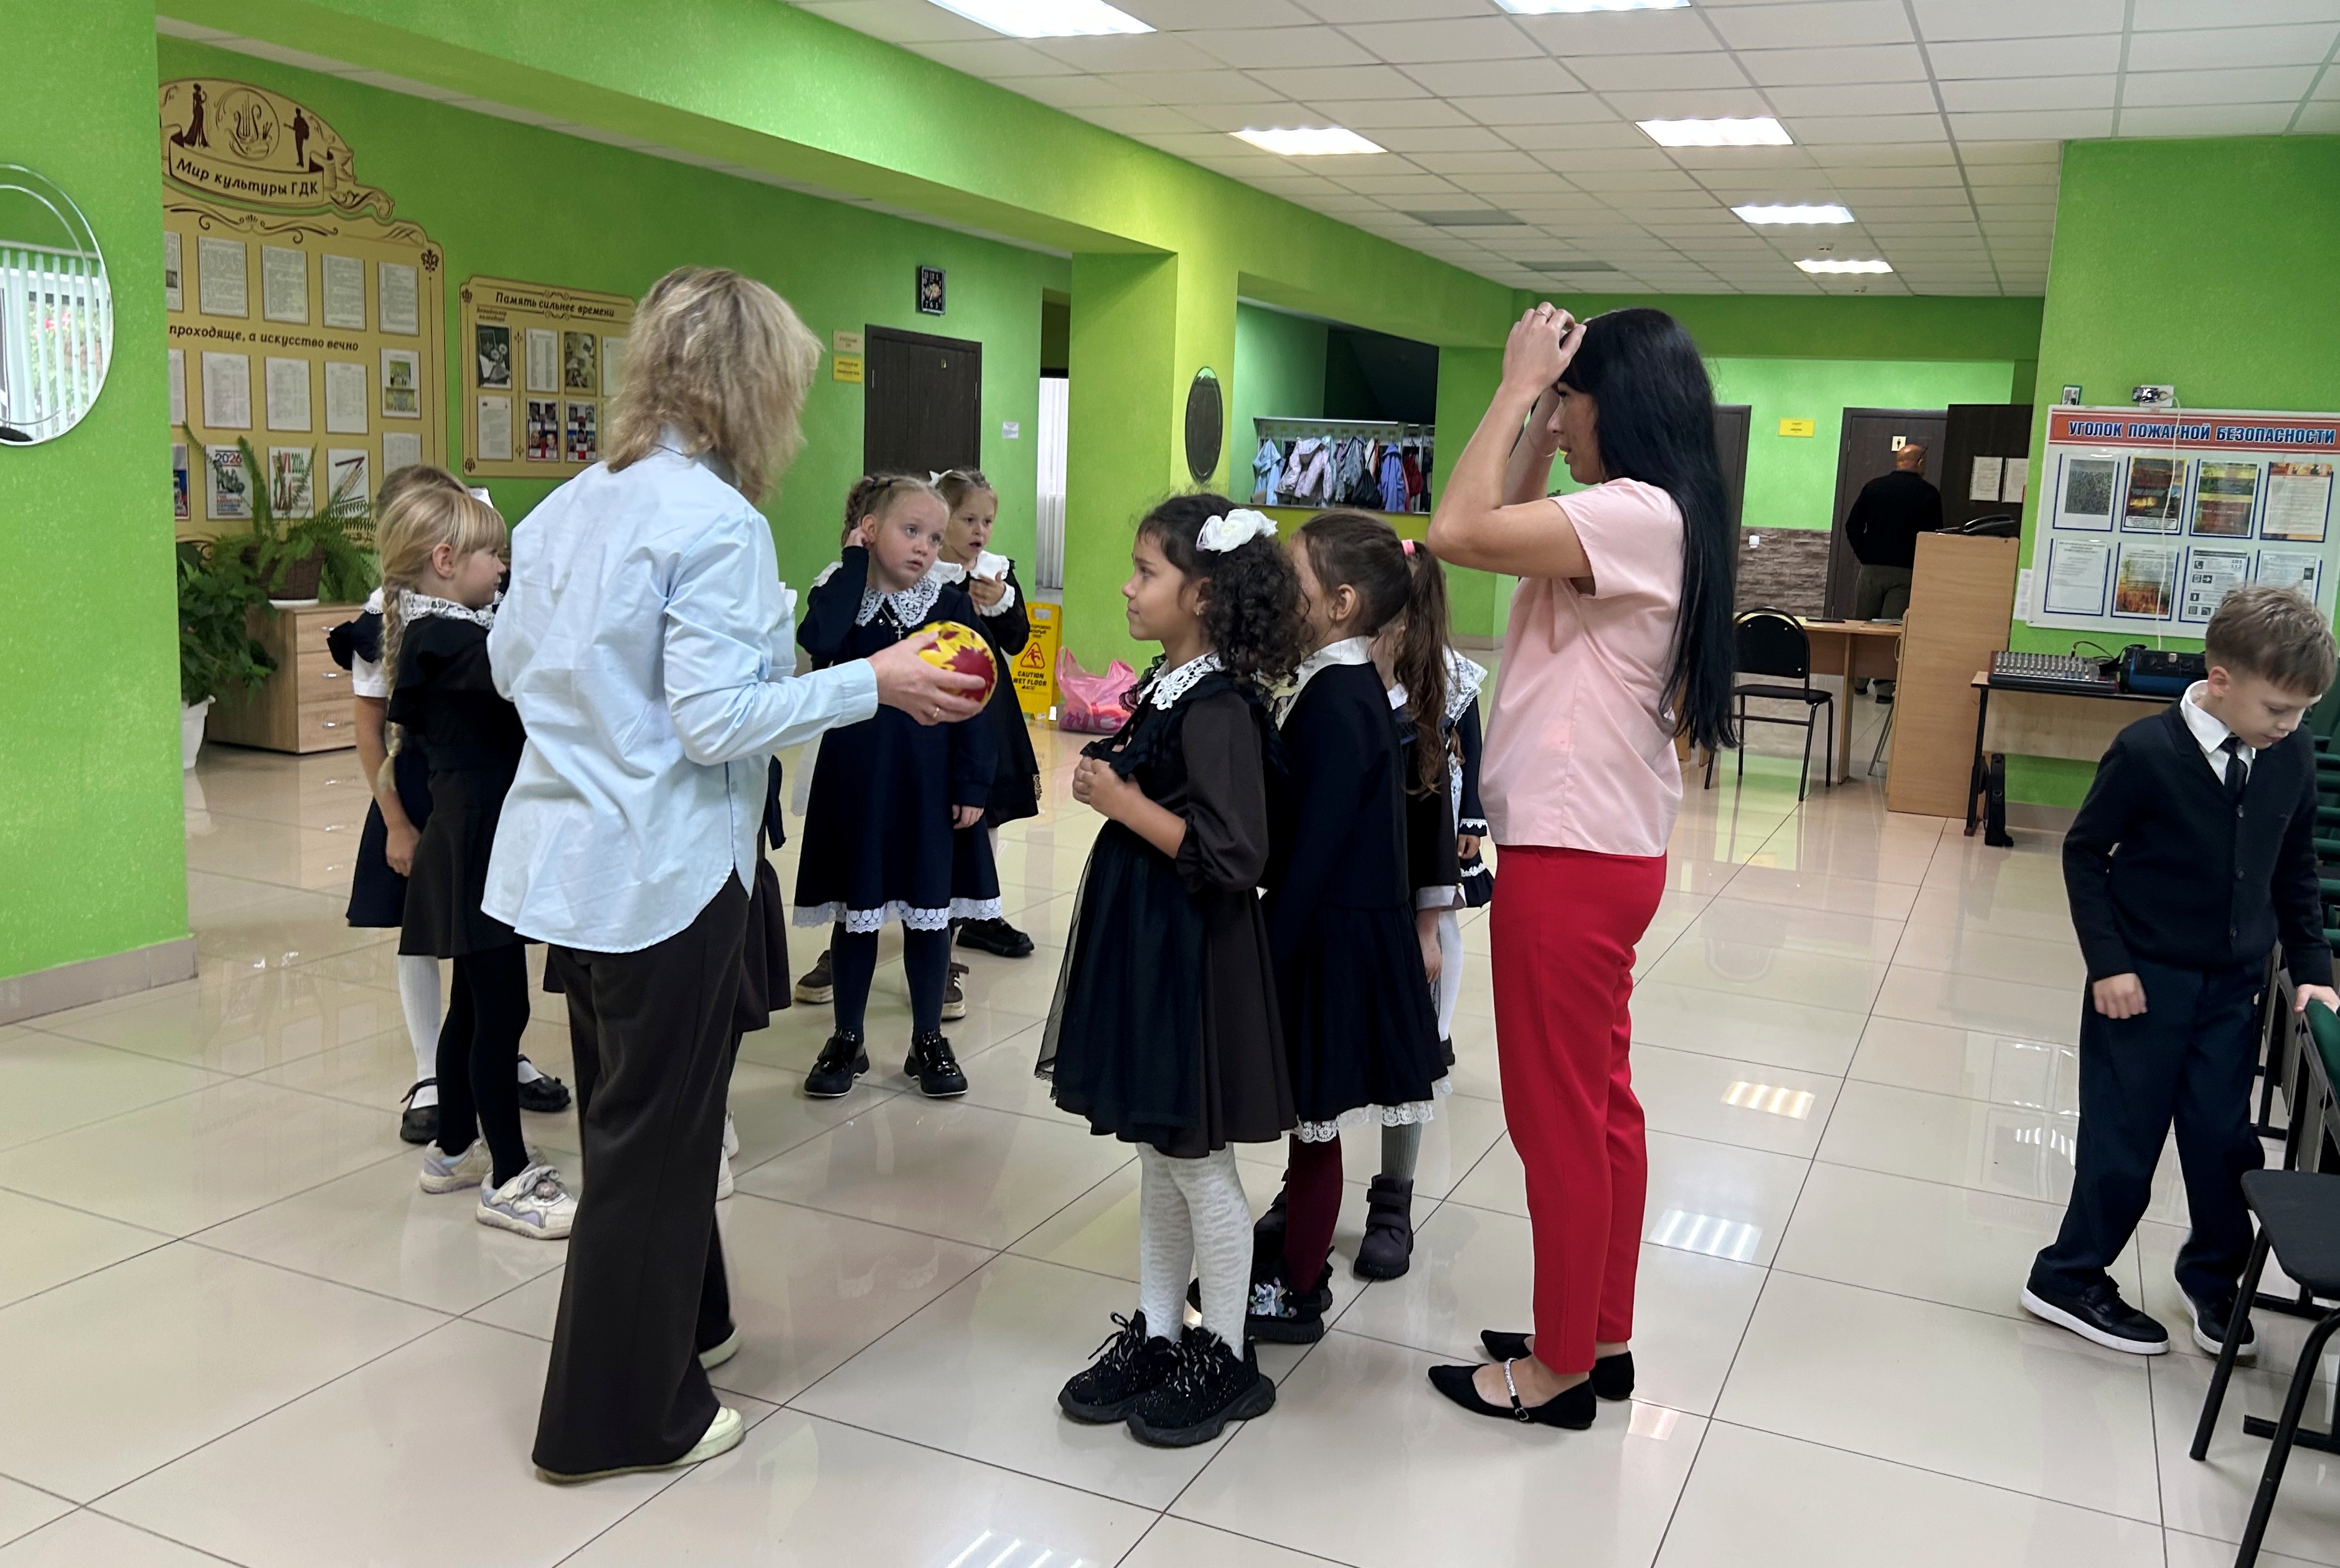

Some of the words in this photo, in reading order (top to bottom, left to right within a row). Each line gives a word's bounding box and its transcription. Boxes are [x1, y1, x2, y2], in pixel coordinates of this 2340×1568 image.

[176, 157, 210, 181] Мир
[214, 173, 287, 197] культуры
[291, 181, 319, 197] ГДК
[495, 291, 537, 308] Память
[539, 299, 575, 312] сильнее
[577, 305, 615, 318] времени
[249, 330, 257, 342] а
[260, 331, 324, 348] искусство
[327, 341, 359, 351] вечно
[2069, 421, 2124, 438] УГОЛОК
[2127, 423, 2211, 441] ПОЖАРНОЙ
[2215, 425, 2336, 445] БЕЗОПАСНОСТИ
[215, 452, 242, 464] 2026
[1017, 671, 1044, 679] CAUTION
